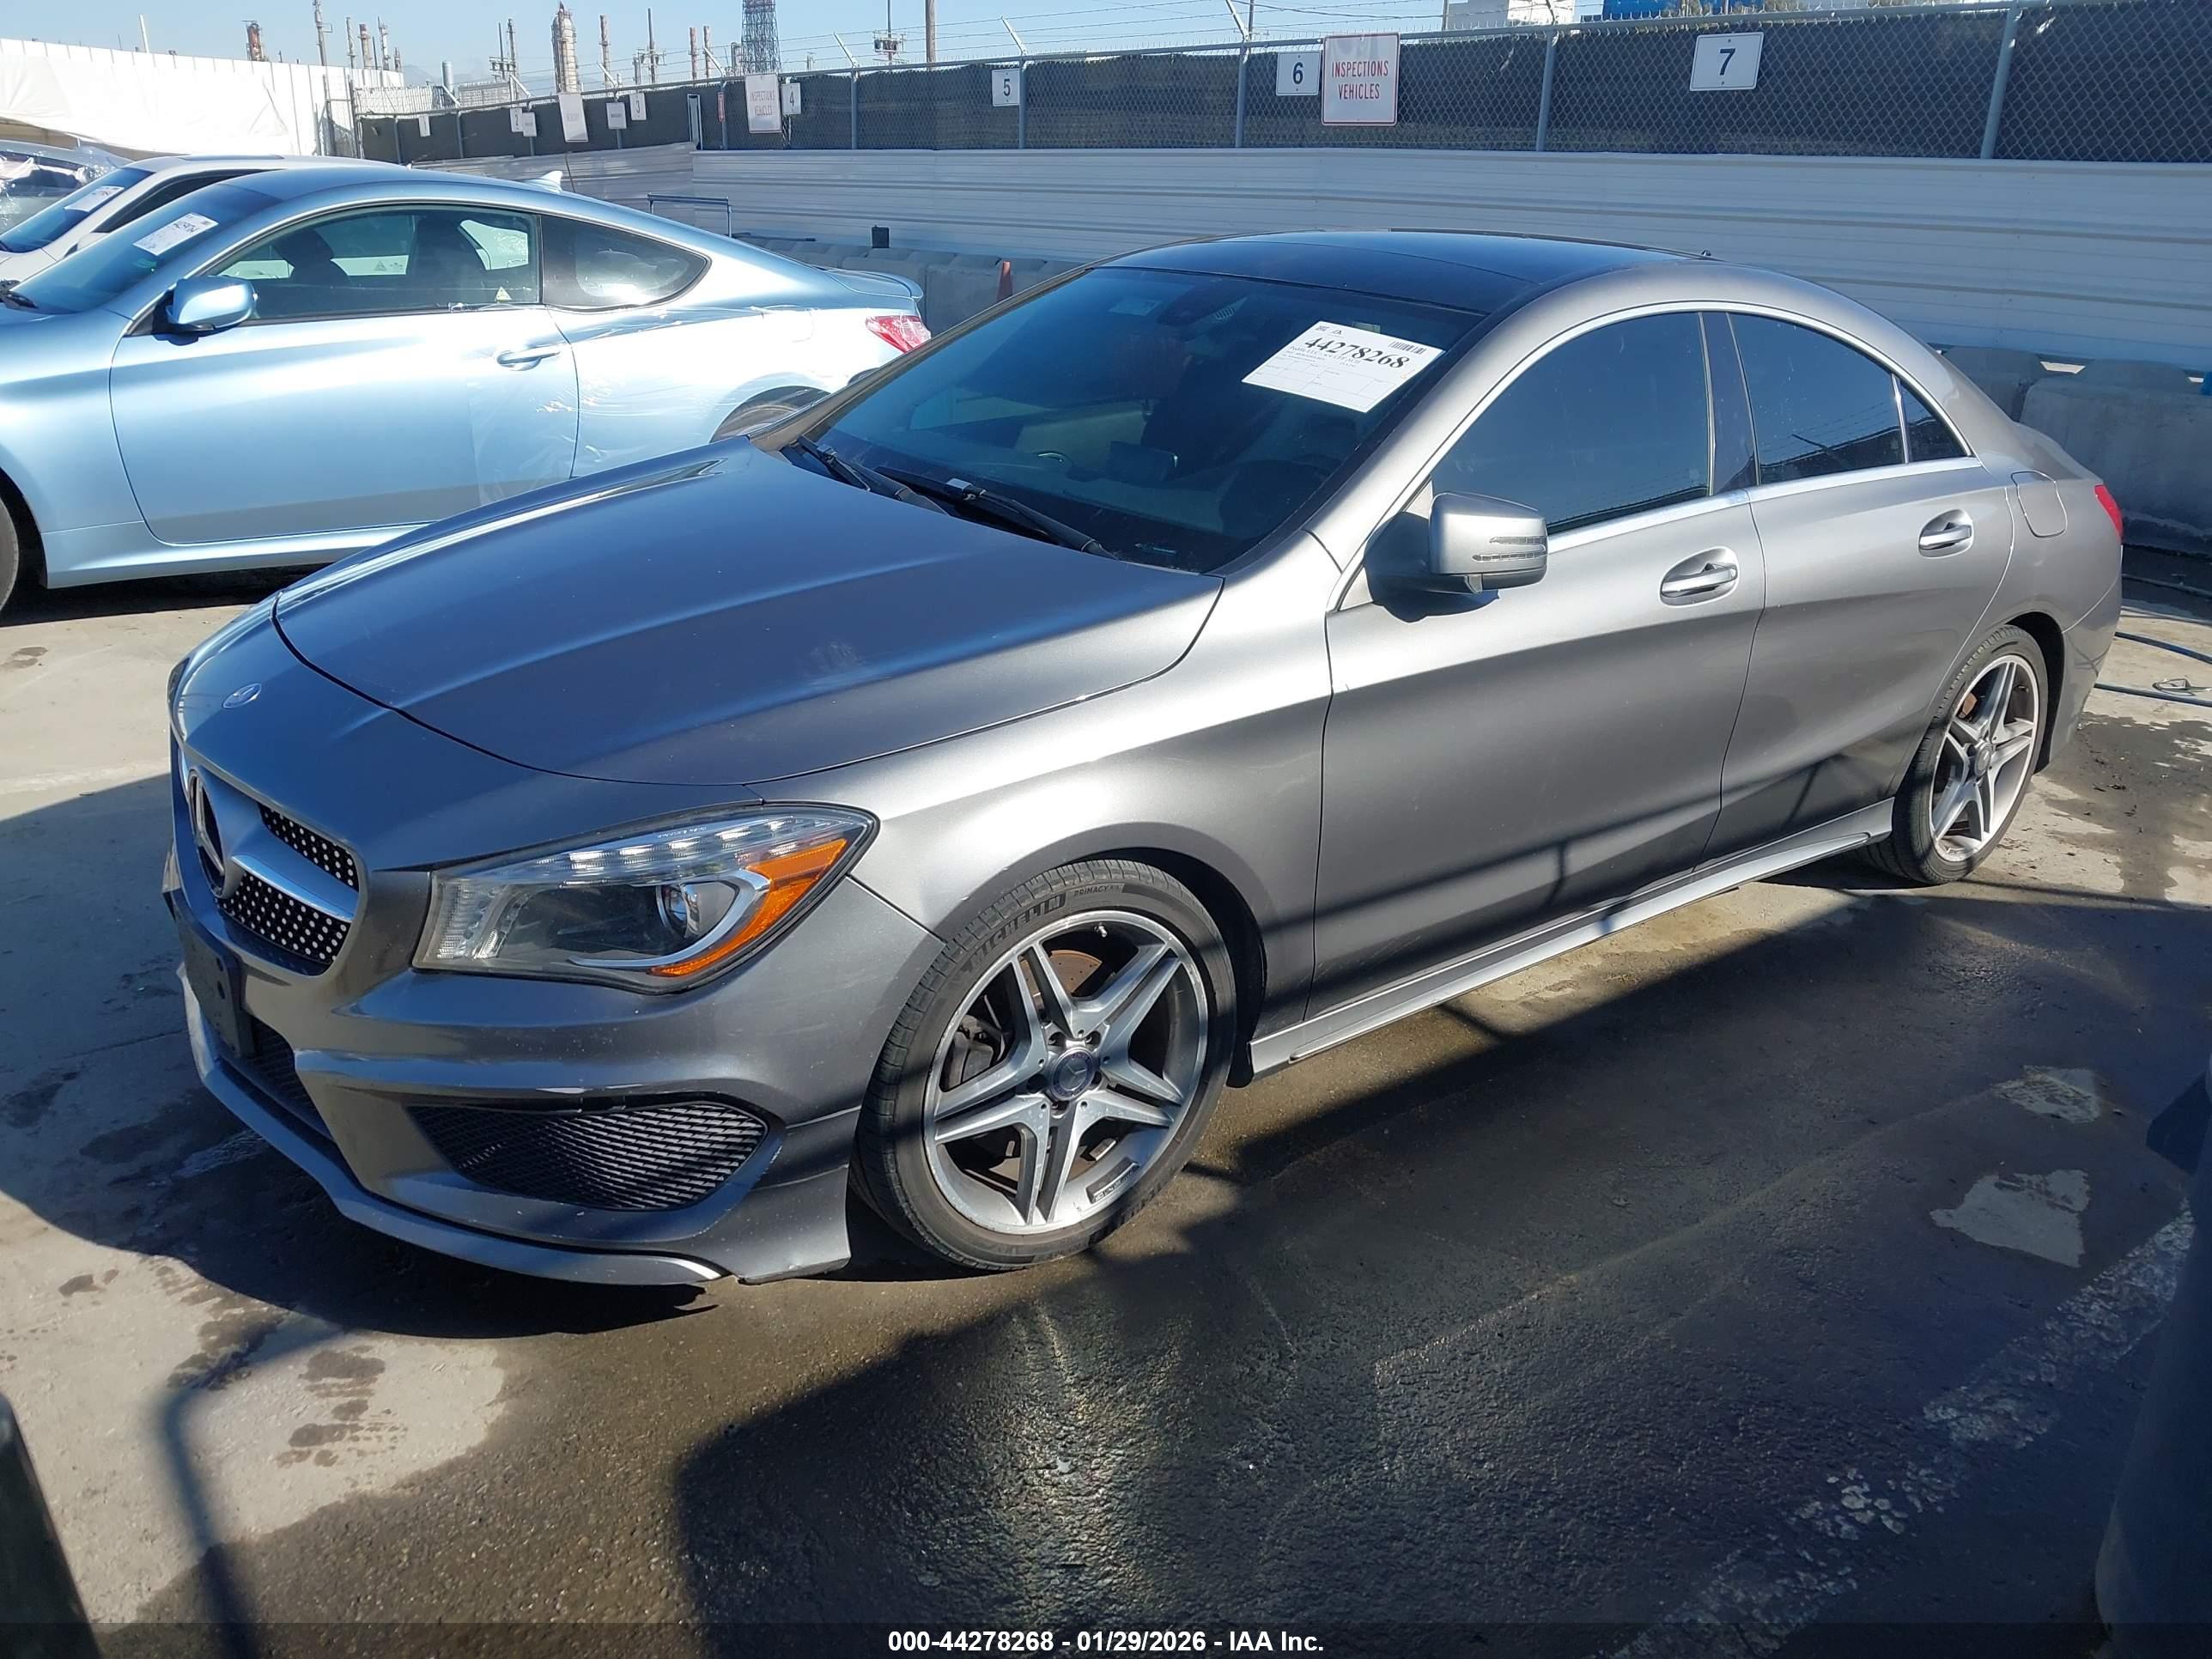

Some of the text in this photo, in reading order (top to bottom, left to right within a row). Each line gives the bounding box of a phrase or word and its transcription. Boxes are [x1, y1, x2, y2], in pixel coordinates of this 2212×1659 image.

[1331, 60, 1389, 78] INSPECTIONS
[1720, 48, 1735, 76] 7
[1292, 62, 1304, 84] 6
[1003, 78, 1011, 97] 5
[1338, 83, 1380, 100] VEHICLES
[789, 90, 794, 107] 4
[1304, 337, 1410, 368] 44278268
[1073, 884, 1109, 897] PRIMACY
